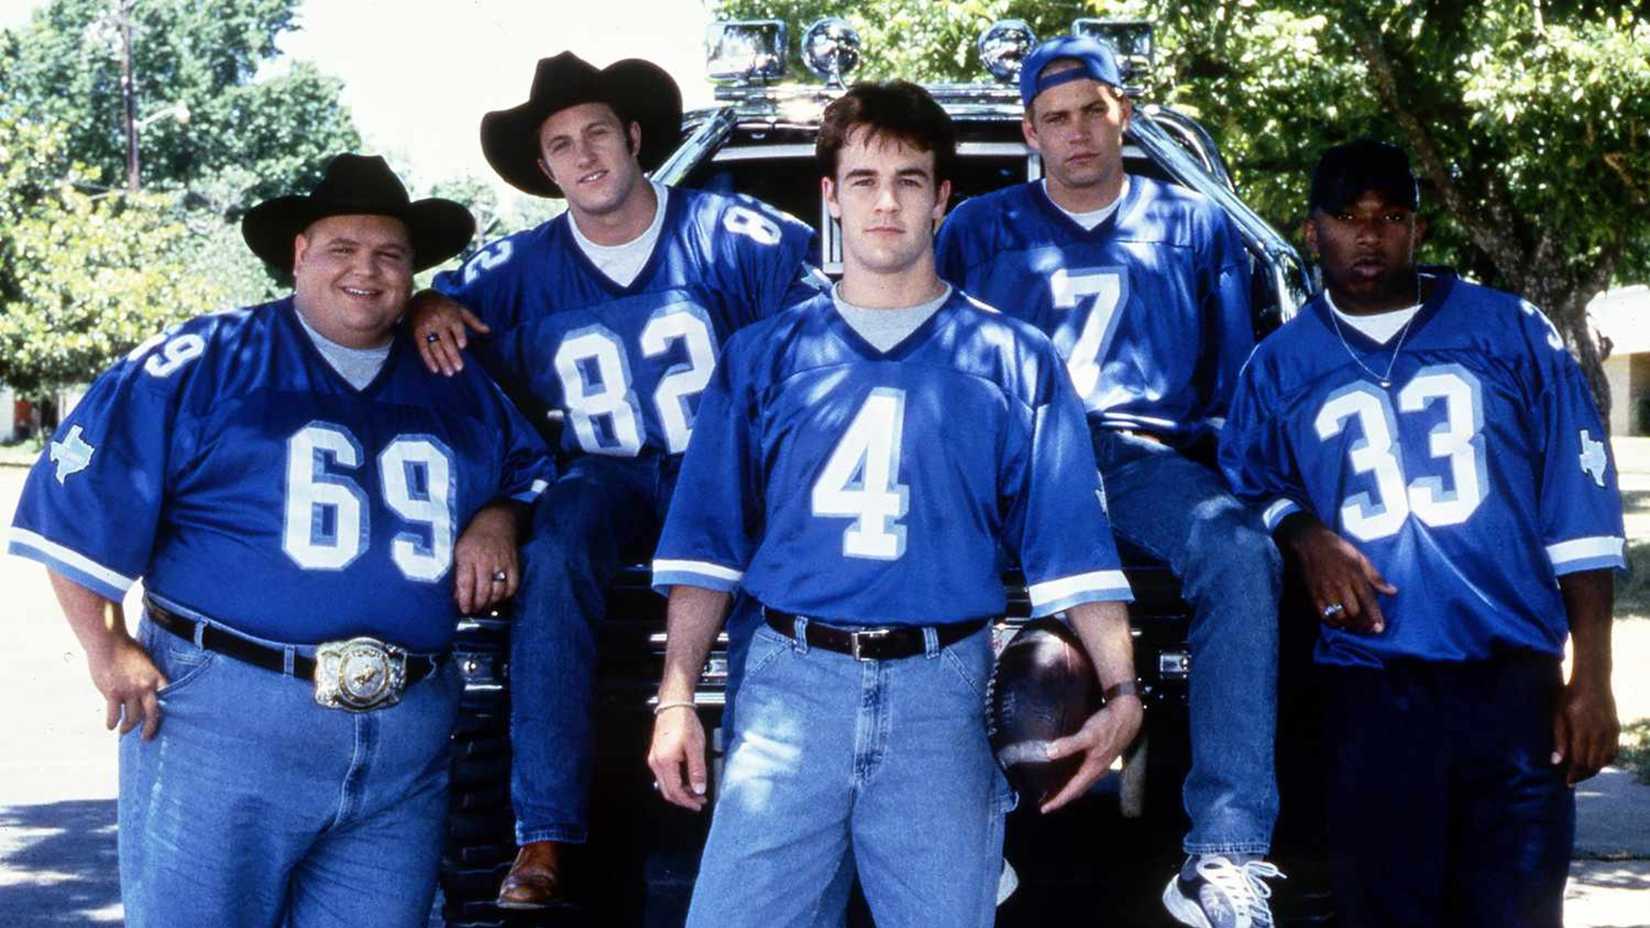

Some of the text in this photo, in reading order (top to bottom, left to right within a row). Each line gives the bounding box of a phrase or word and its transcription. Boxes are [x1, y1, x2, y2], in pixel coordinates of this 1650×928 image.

[554, 301, 720, 457] 82
[1050, 265, 1129, 401] 7
[282, 420, 457, 583] 69
[811, 386, 910, 561] 4
[1314, 363, 1490, 542] 33
